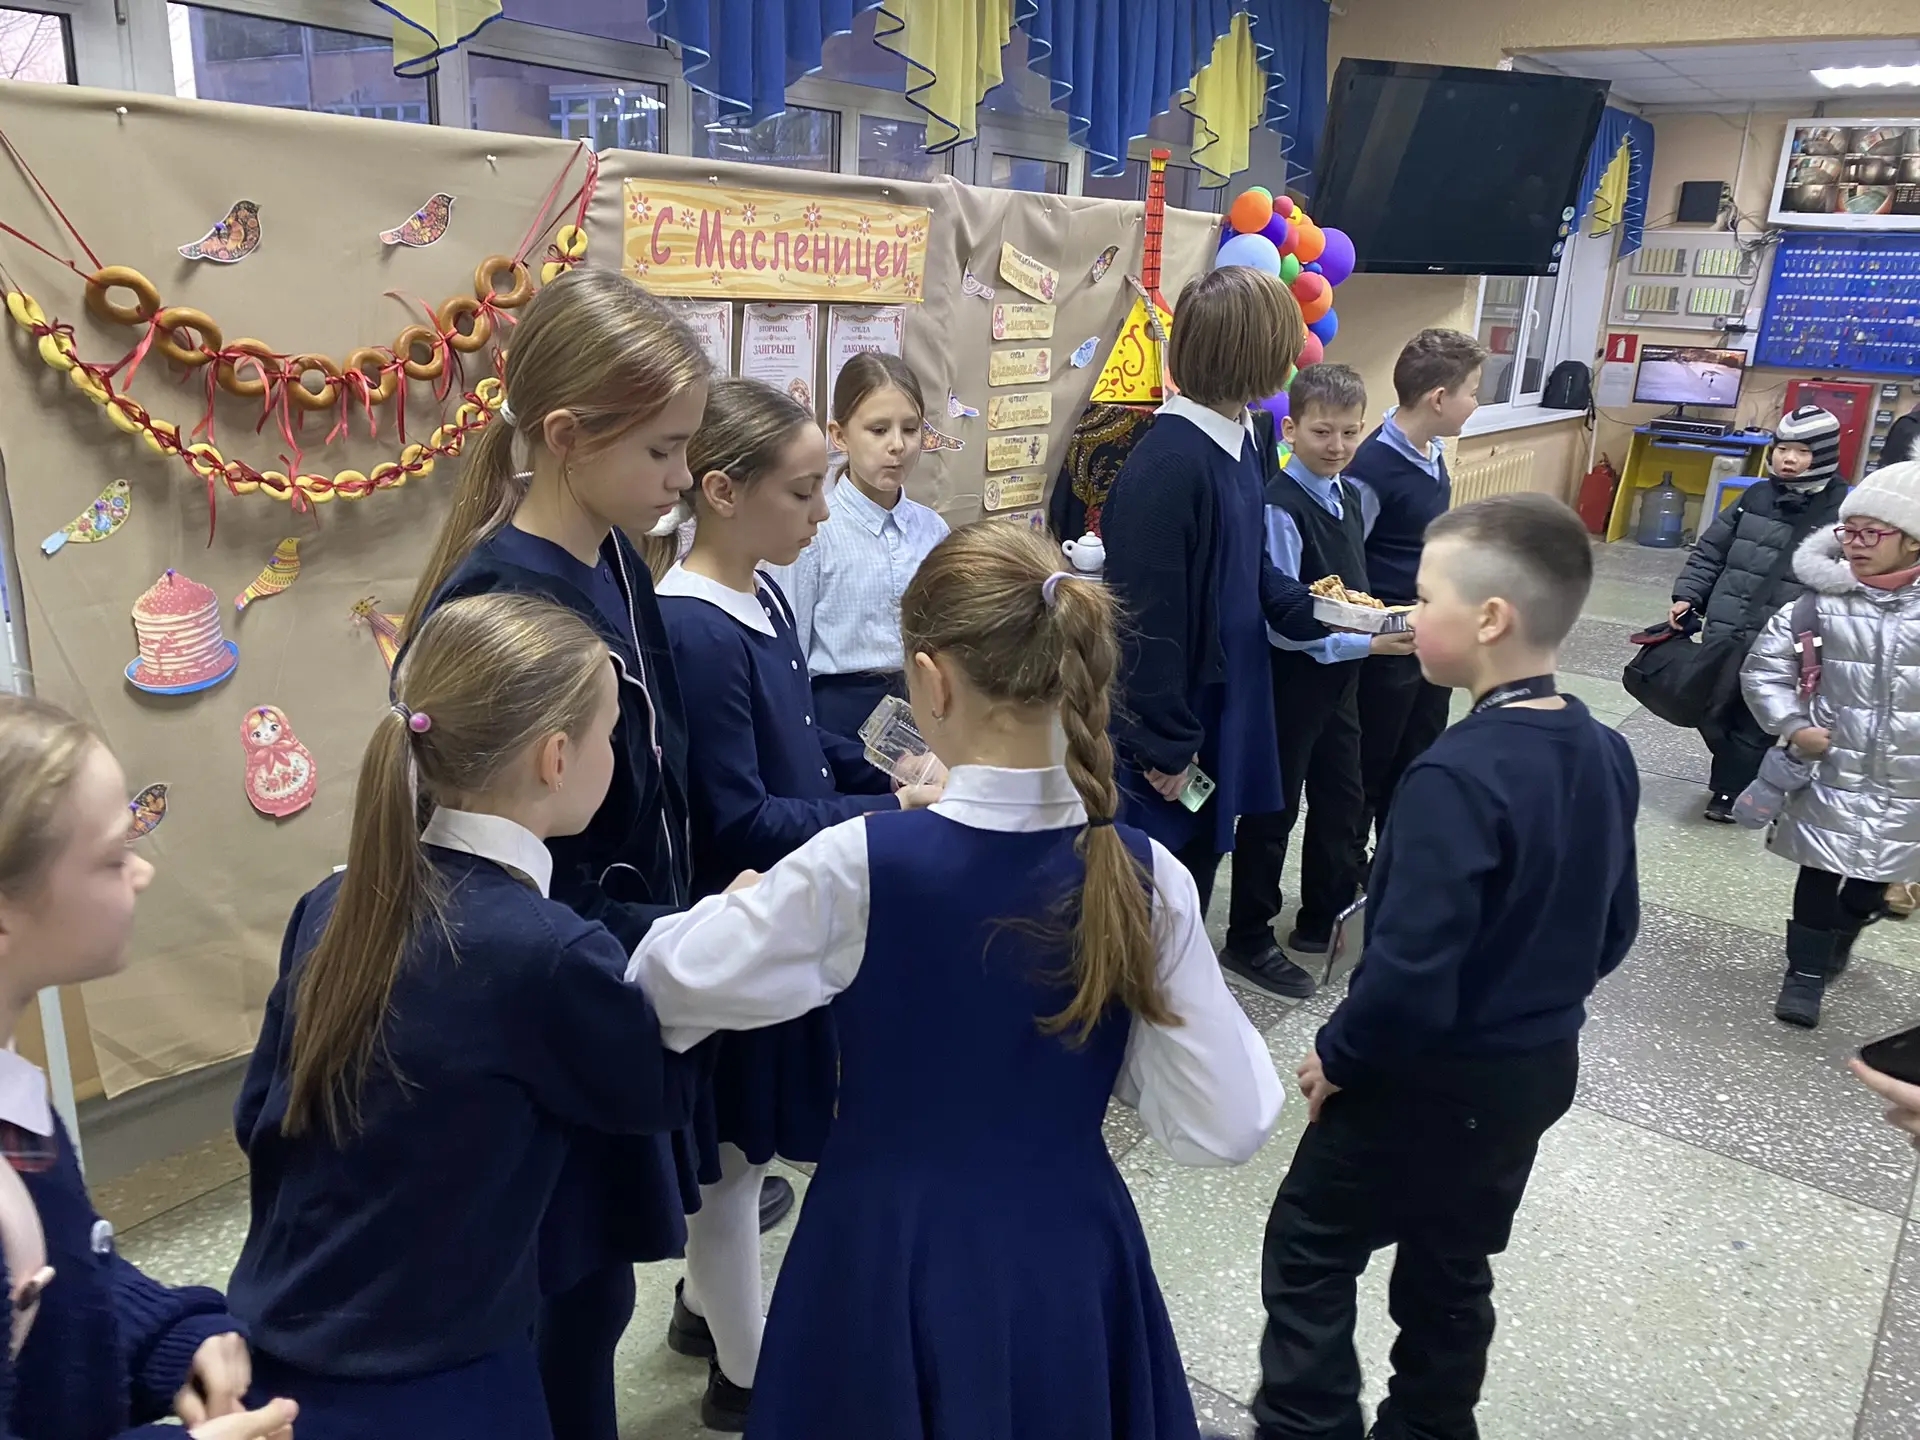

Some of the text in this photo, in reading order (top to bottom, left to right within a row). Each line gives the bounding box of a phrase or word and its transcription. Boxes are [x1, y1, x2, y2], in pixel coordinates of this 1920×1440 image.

[651, 206, 908, 282] С Масленицей
[758, 325, 788, 333] ВТОРНИК
[752, 344, 795, 355] ЗАИГРЫШ
